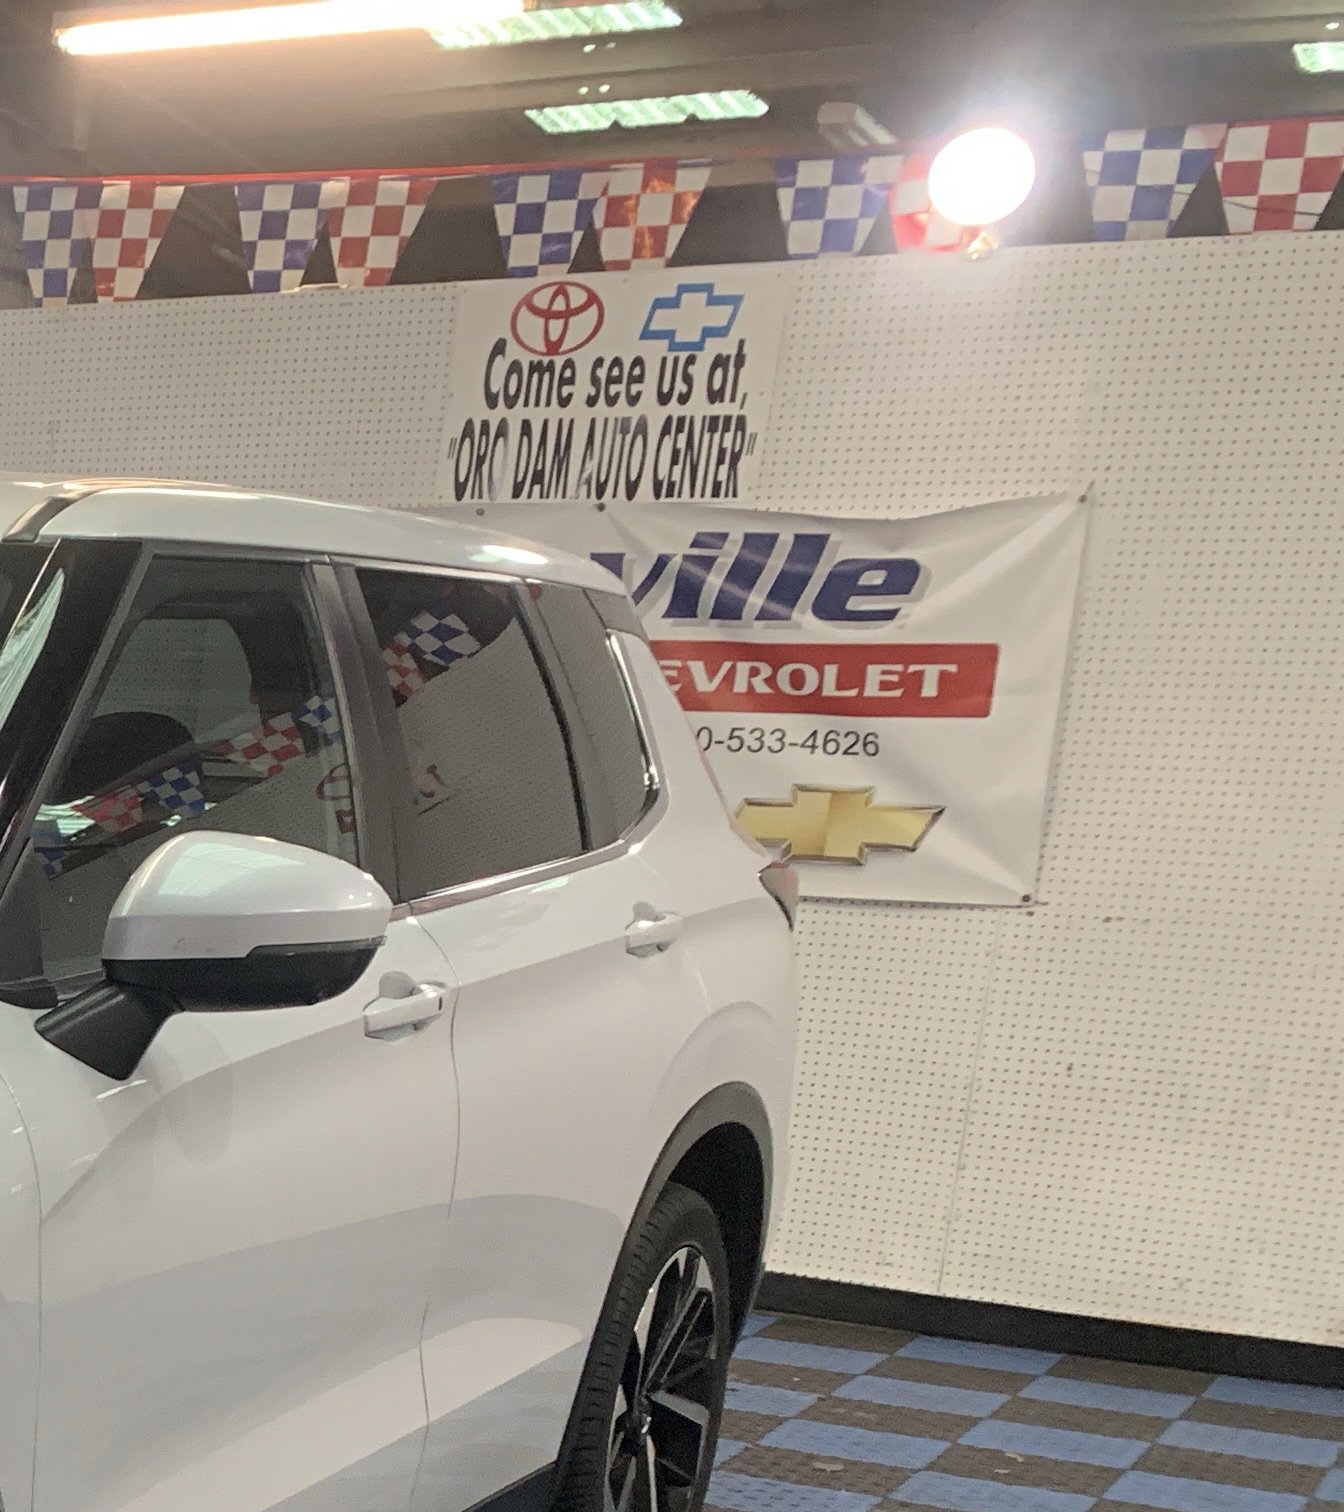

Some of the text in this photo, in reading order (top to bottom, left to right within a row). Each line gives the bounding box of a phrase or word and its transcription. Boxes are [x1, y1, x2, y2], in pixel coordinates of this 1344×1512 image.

[484, 337, 749, 410] Come see us at,
[448, 413, 758, 502] "ORO DAM AUTO CENTER"
